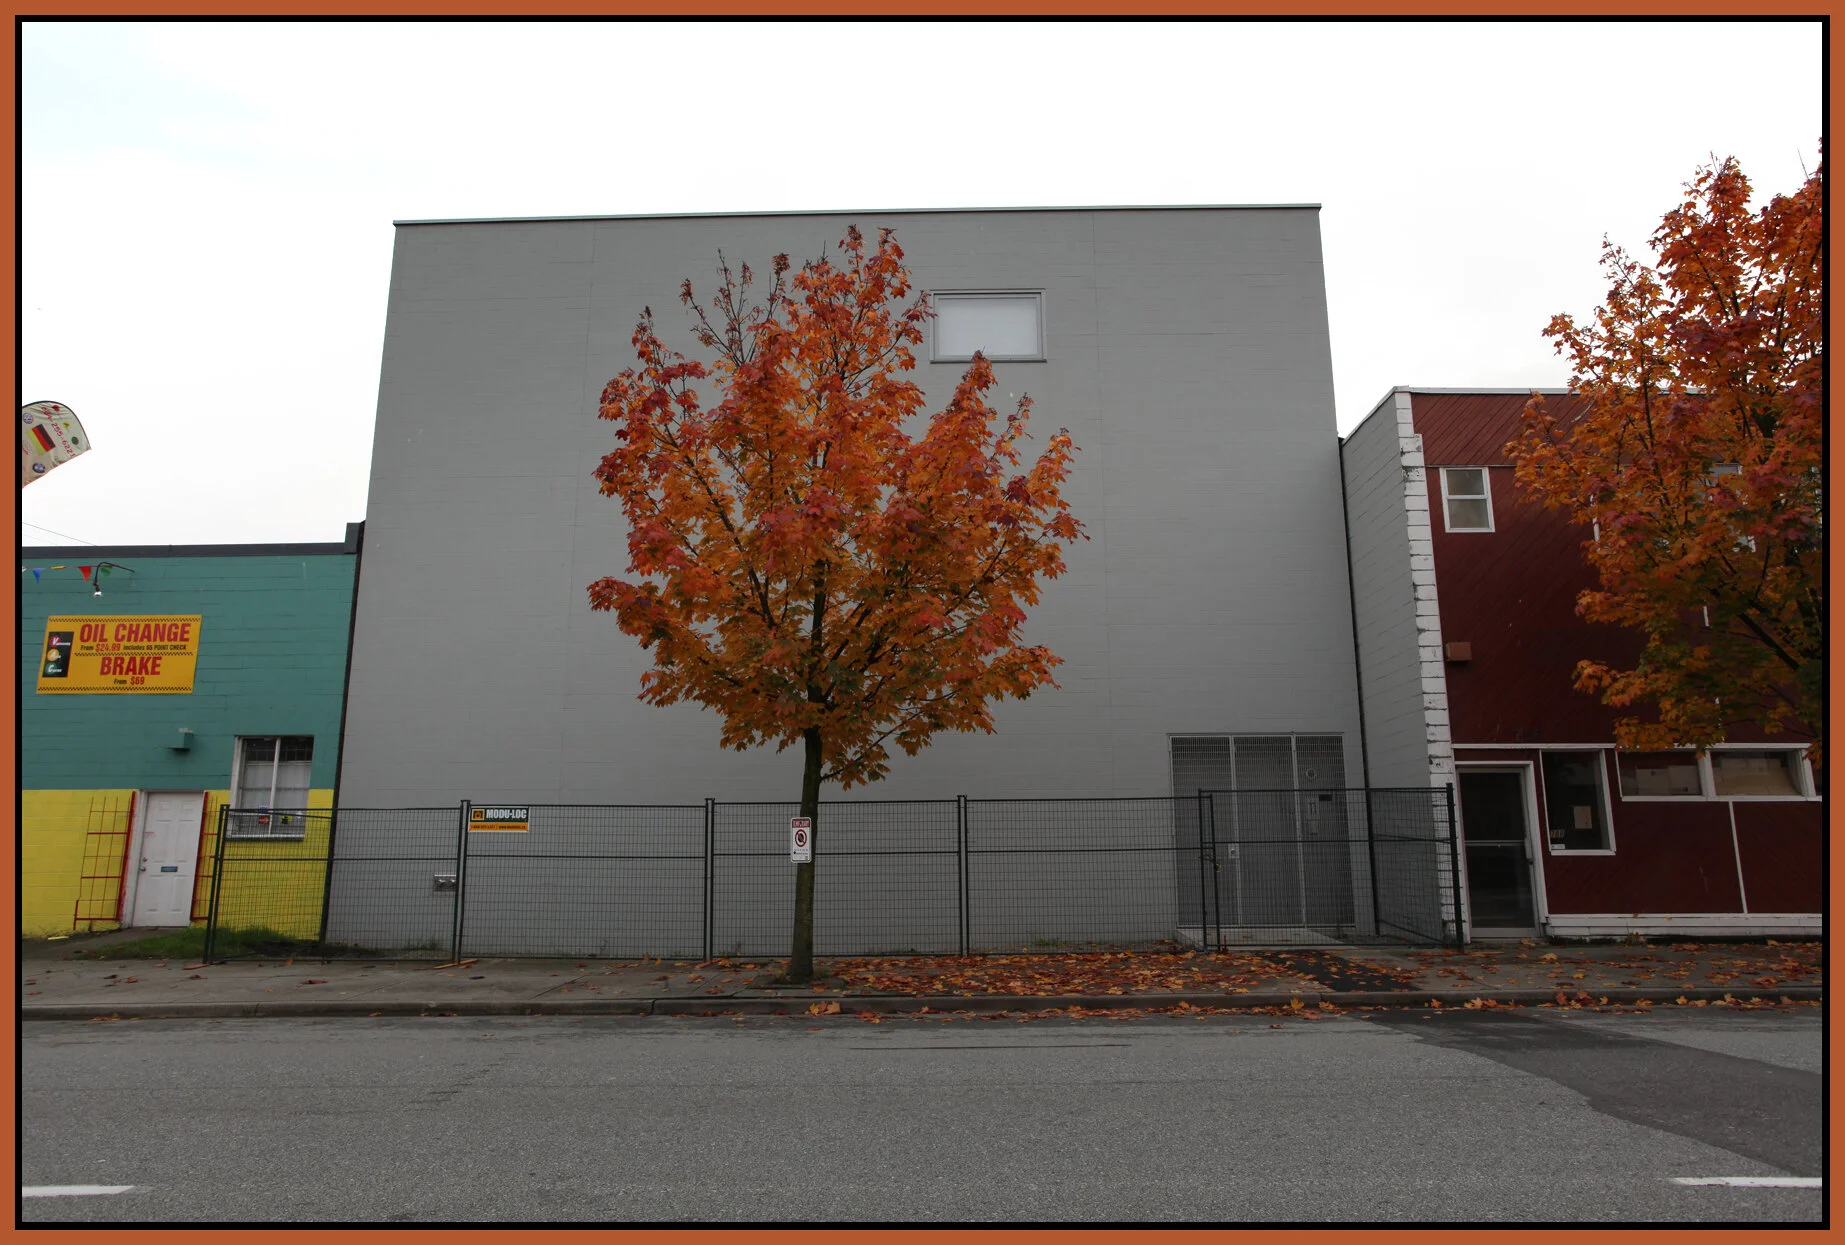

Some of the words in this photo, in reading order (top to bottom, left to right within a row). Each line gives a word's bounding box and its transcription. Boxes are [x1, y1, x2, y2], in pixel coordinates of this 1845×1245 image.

[79, 623, 108, 643] OIL
[114, 623, 191, 643] CHANGE
[95, 643, 120, 653] $24.99
[100, 656, 162, 676] BRAKE
[130, 676, 145, 686] $69
